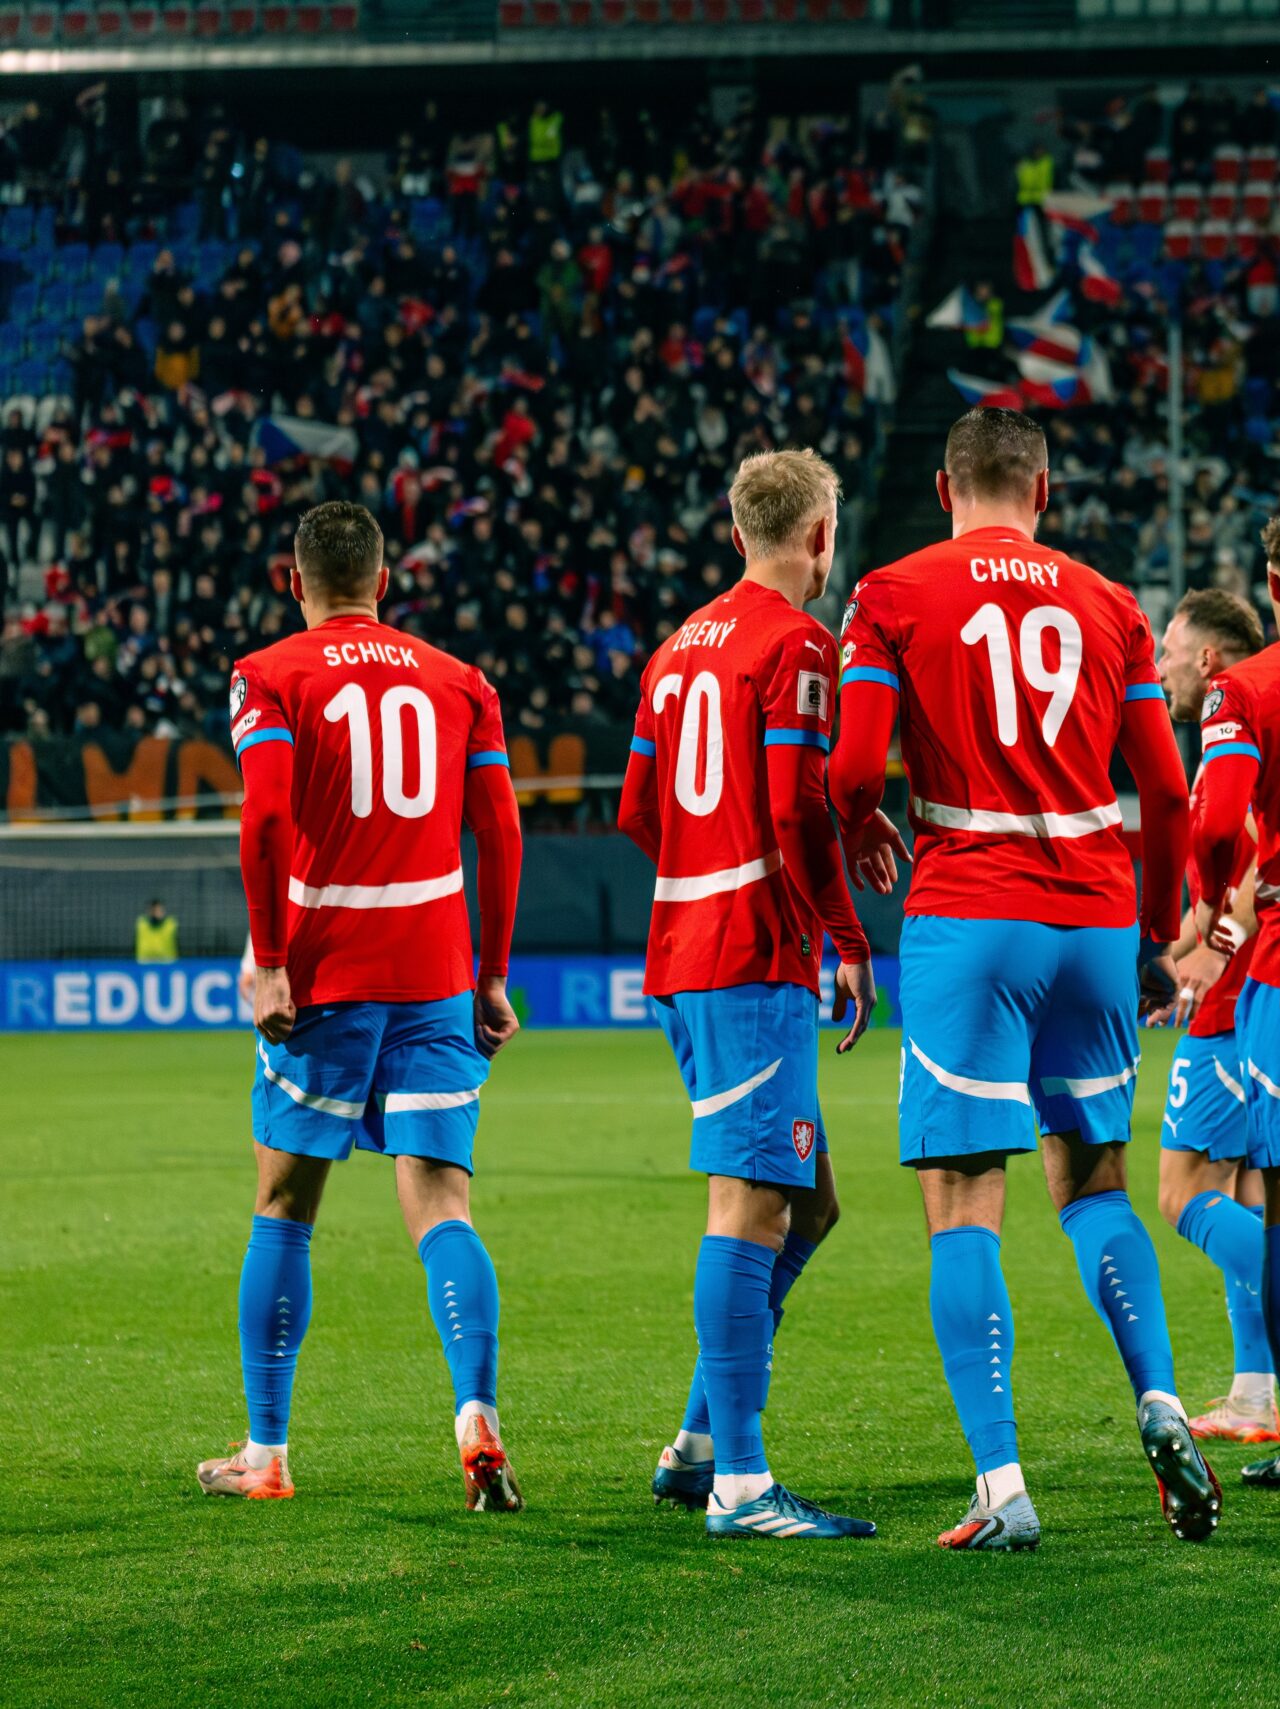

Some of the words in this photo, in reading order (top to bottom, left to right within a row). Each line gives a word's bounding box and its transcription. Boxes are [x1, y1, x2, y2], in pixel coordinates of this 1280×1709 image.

[970, 557, 1060, 588] CHORÝ
[323, 641, 419, 669] SCHICK
[672, 618, 738, 652] ZELENÝ
[960, 602, 1083, 748] 19
[323, 682, 437, 819] 10
[1169, 1057, 1192, 1108] 5
